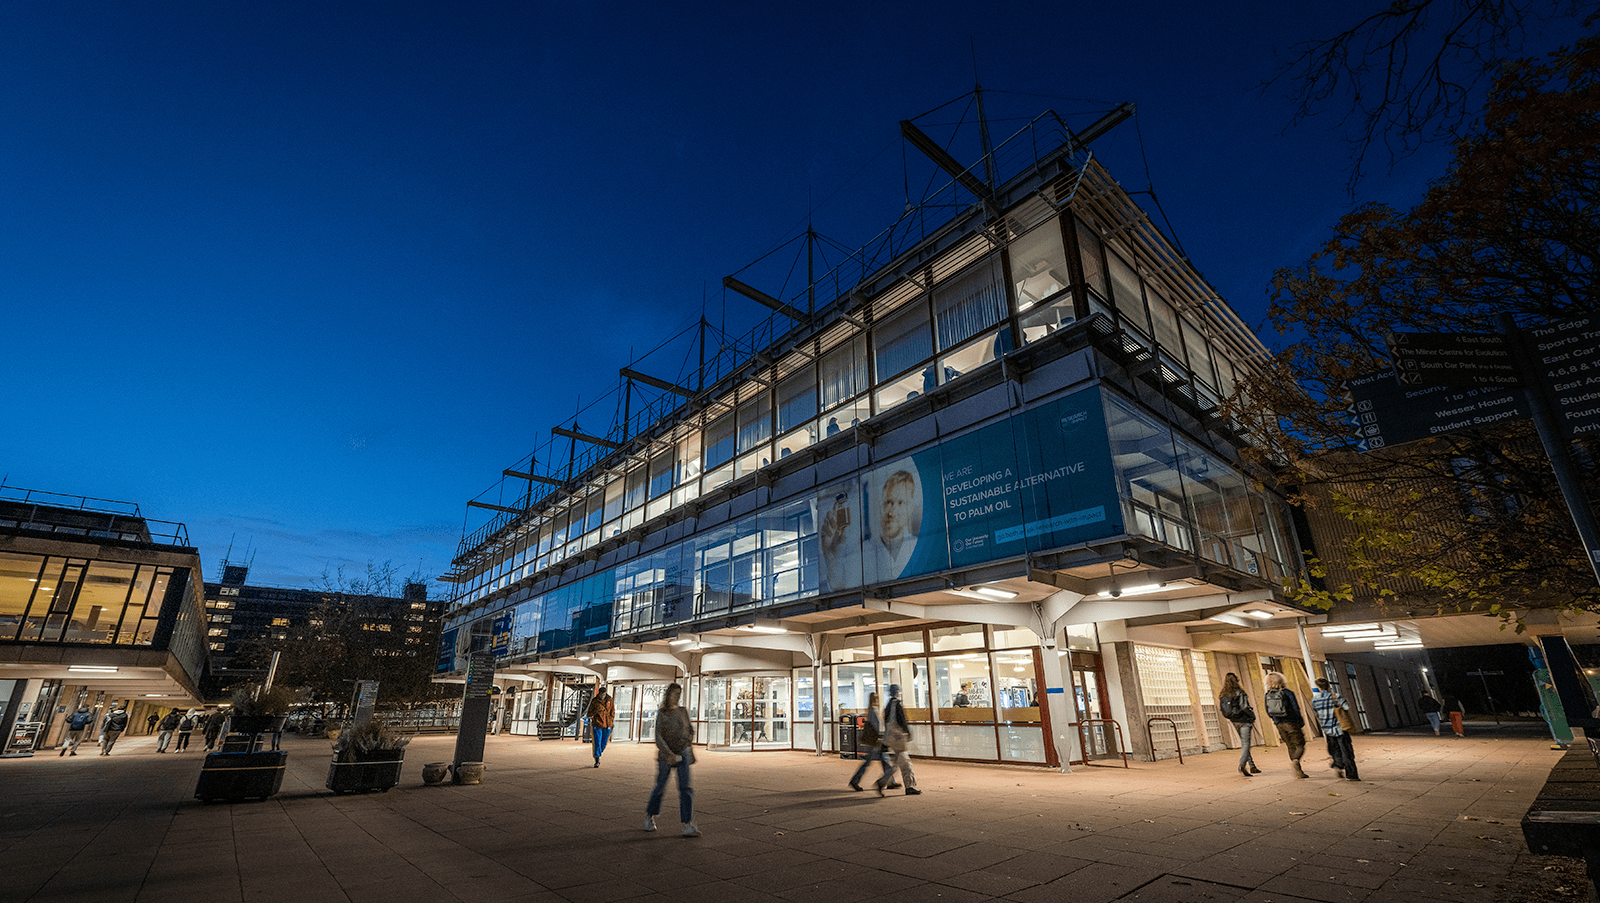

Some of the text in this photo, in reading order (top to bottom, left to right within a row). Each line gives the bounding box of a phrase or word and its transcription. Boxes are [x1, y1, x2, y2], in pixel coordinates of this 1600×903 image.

[1532, 319, 1590, 337] The Edge
[1538, 336, 1579, 351] Sports
[1415, 348, 1437, 356] Milner
[1438, 348, 1463, 356] Centre
[1542, 346, 1595, 364] East Car
[1420, 361, 1443, 369] South
[1444, 361, 1458, 369] Car
[1580, 363, 1590, 371] &
[1351, 376, 1375, 387] West
[1554, 380, 1582, 391] East
[1452, 393, 1464, 401] to
[1467, 389, 1478, 398] 10
[1435, 395, 1514, 418] Wessex House
[1430, 408, 1519, 434] Student Support
[956, 465, 972, 478] ARE
[946, 468, 1012, 495] DEVELOPING A
[950, 461, 1085, 508] SUSTAINABLE ALTERNATIVE
[954, 499, 1011, 522] TO PALM OIL
